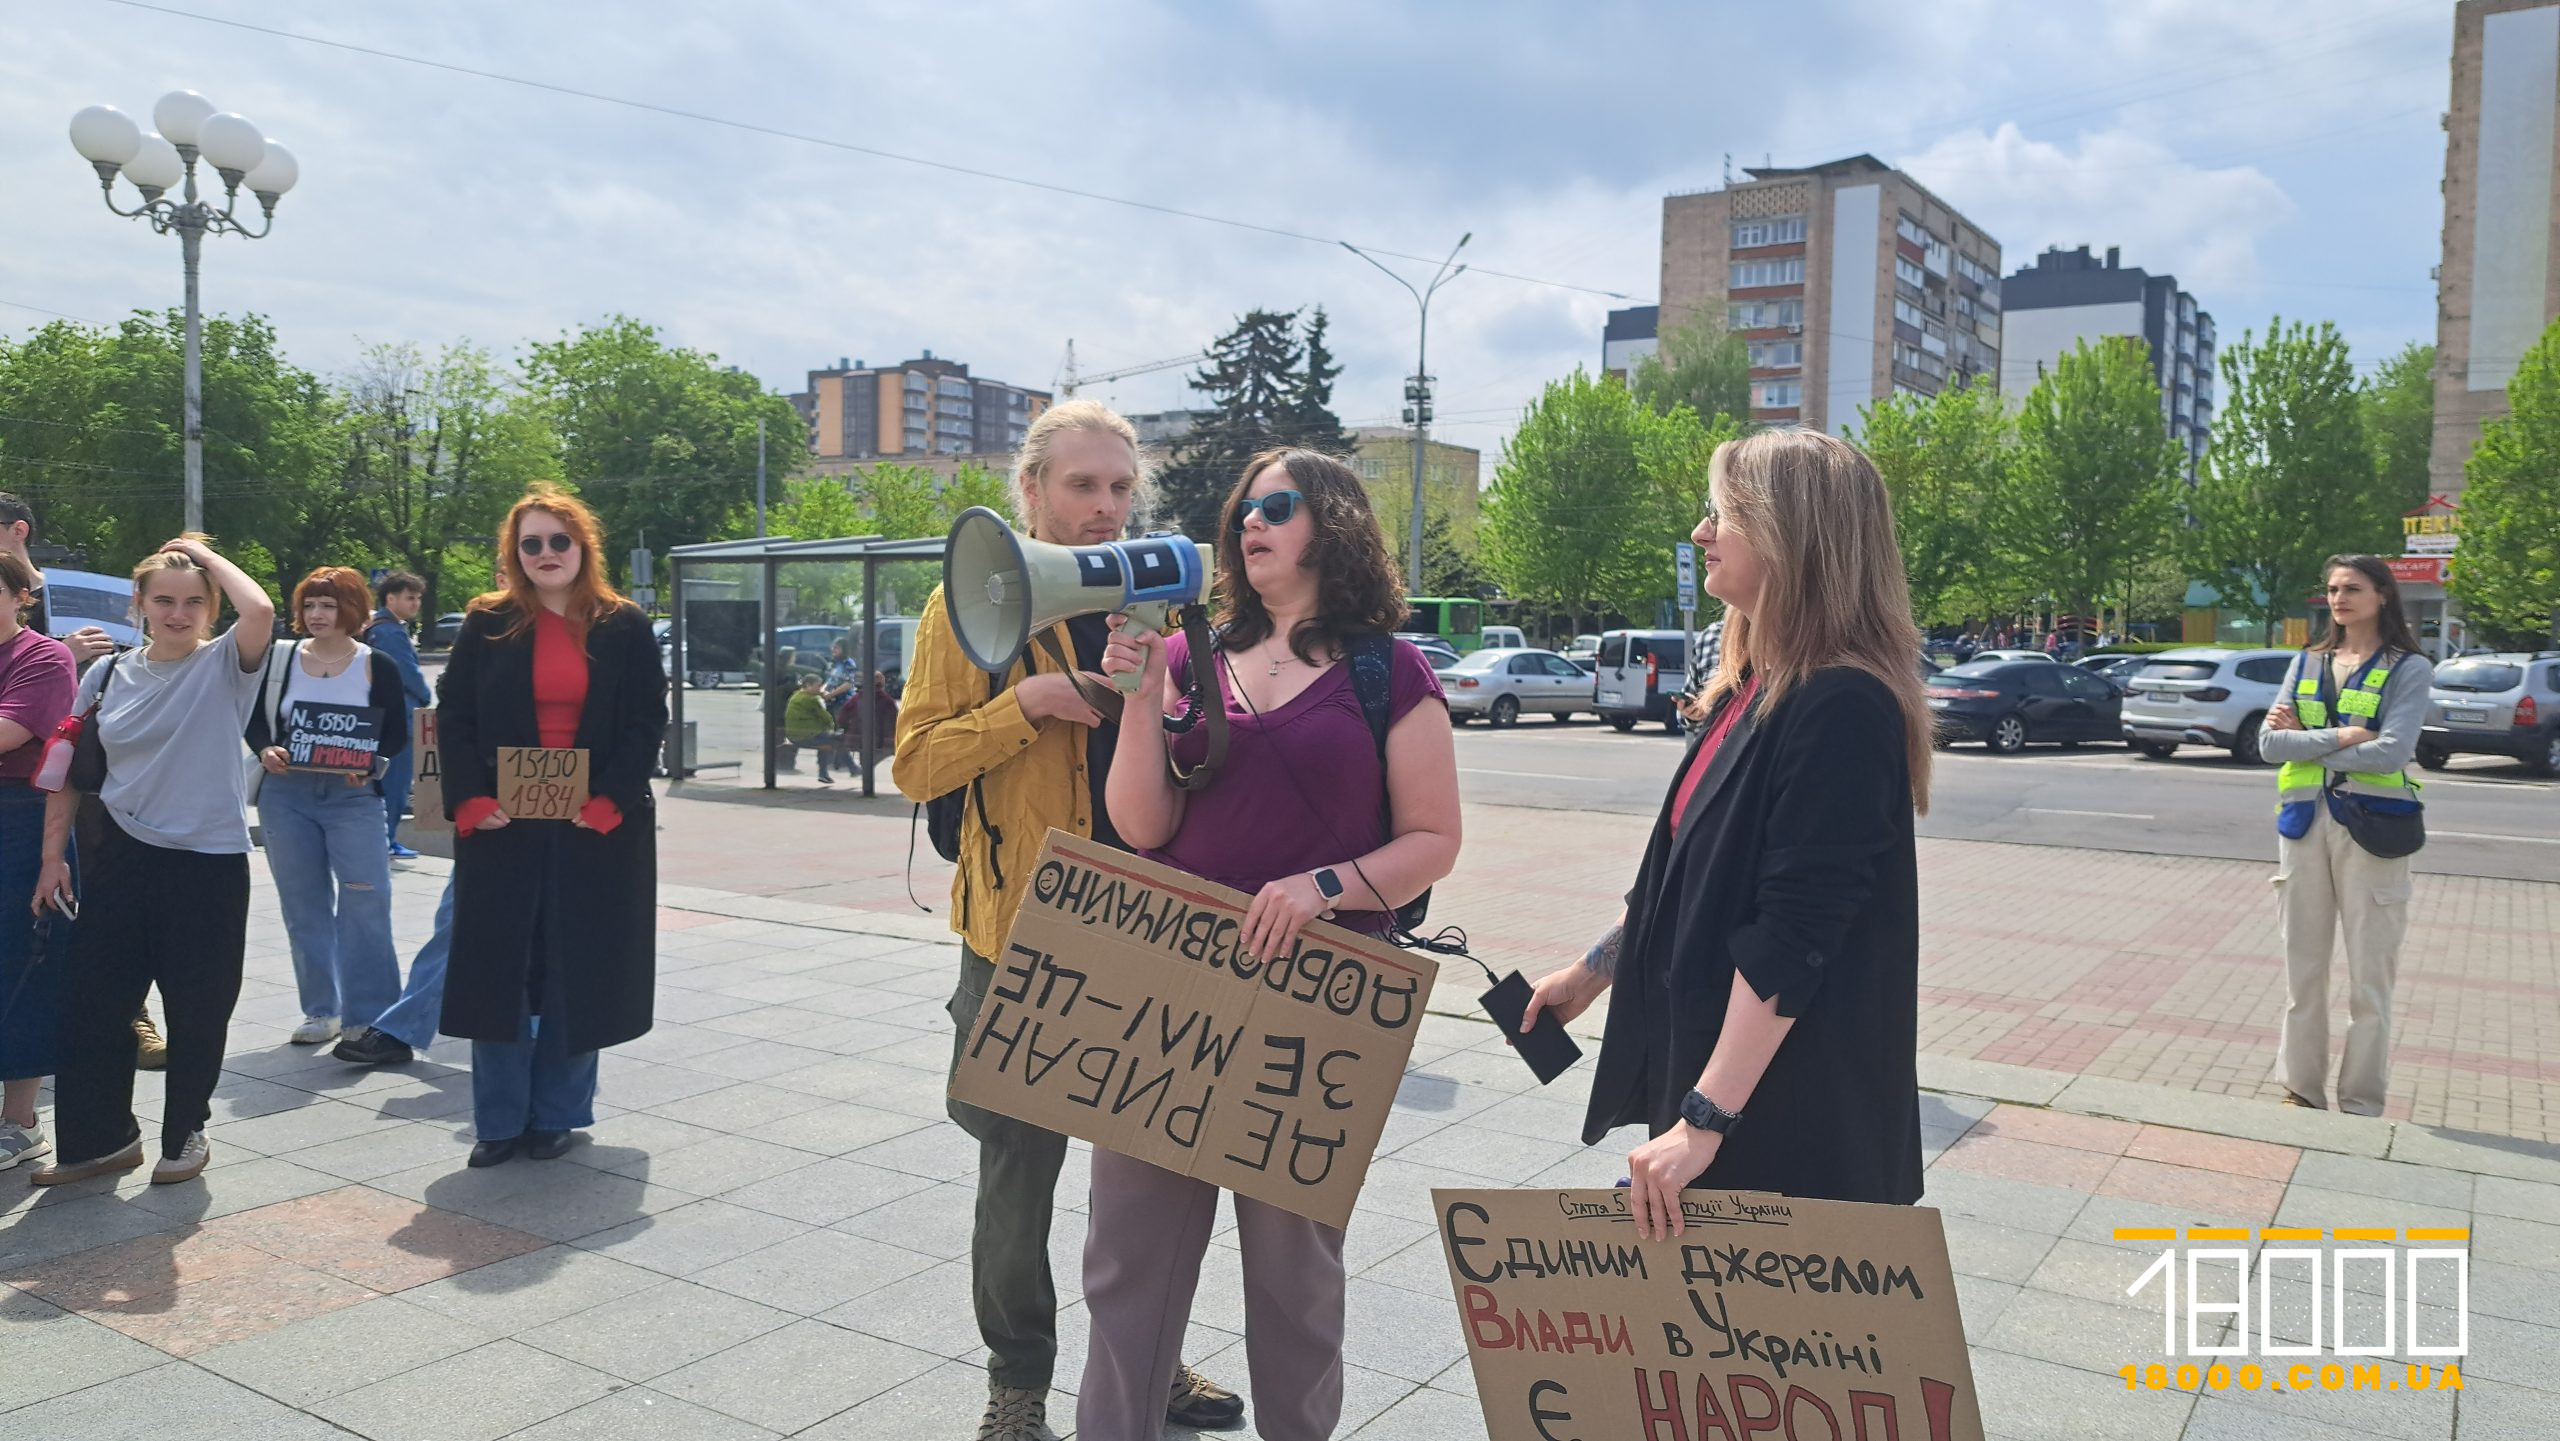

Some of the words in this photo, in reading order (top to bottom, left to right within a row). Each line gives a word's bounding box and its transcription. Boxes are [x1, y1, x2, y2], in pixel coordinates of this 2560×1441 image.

[289, 742, 312, 763] ЧИ
[506, 749, 577, 778] 15150
[510, 784, 575, 817] 1984
[1613, 1192, 1626, 1212] 5
[1728, 1194, 1793, 1222] України
[1446, 1201, 1649, 1284] Єдиним
[1680, 1242, 1924, 1300] джерелом
[1687, 1289, 1883, 1379] Україні
